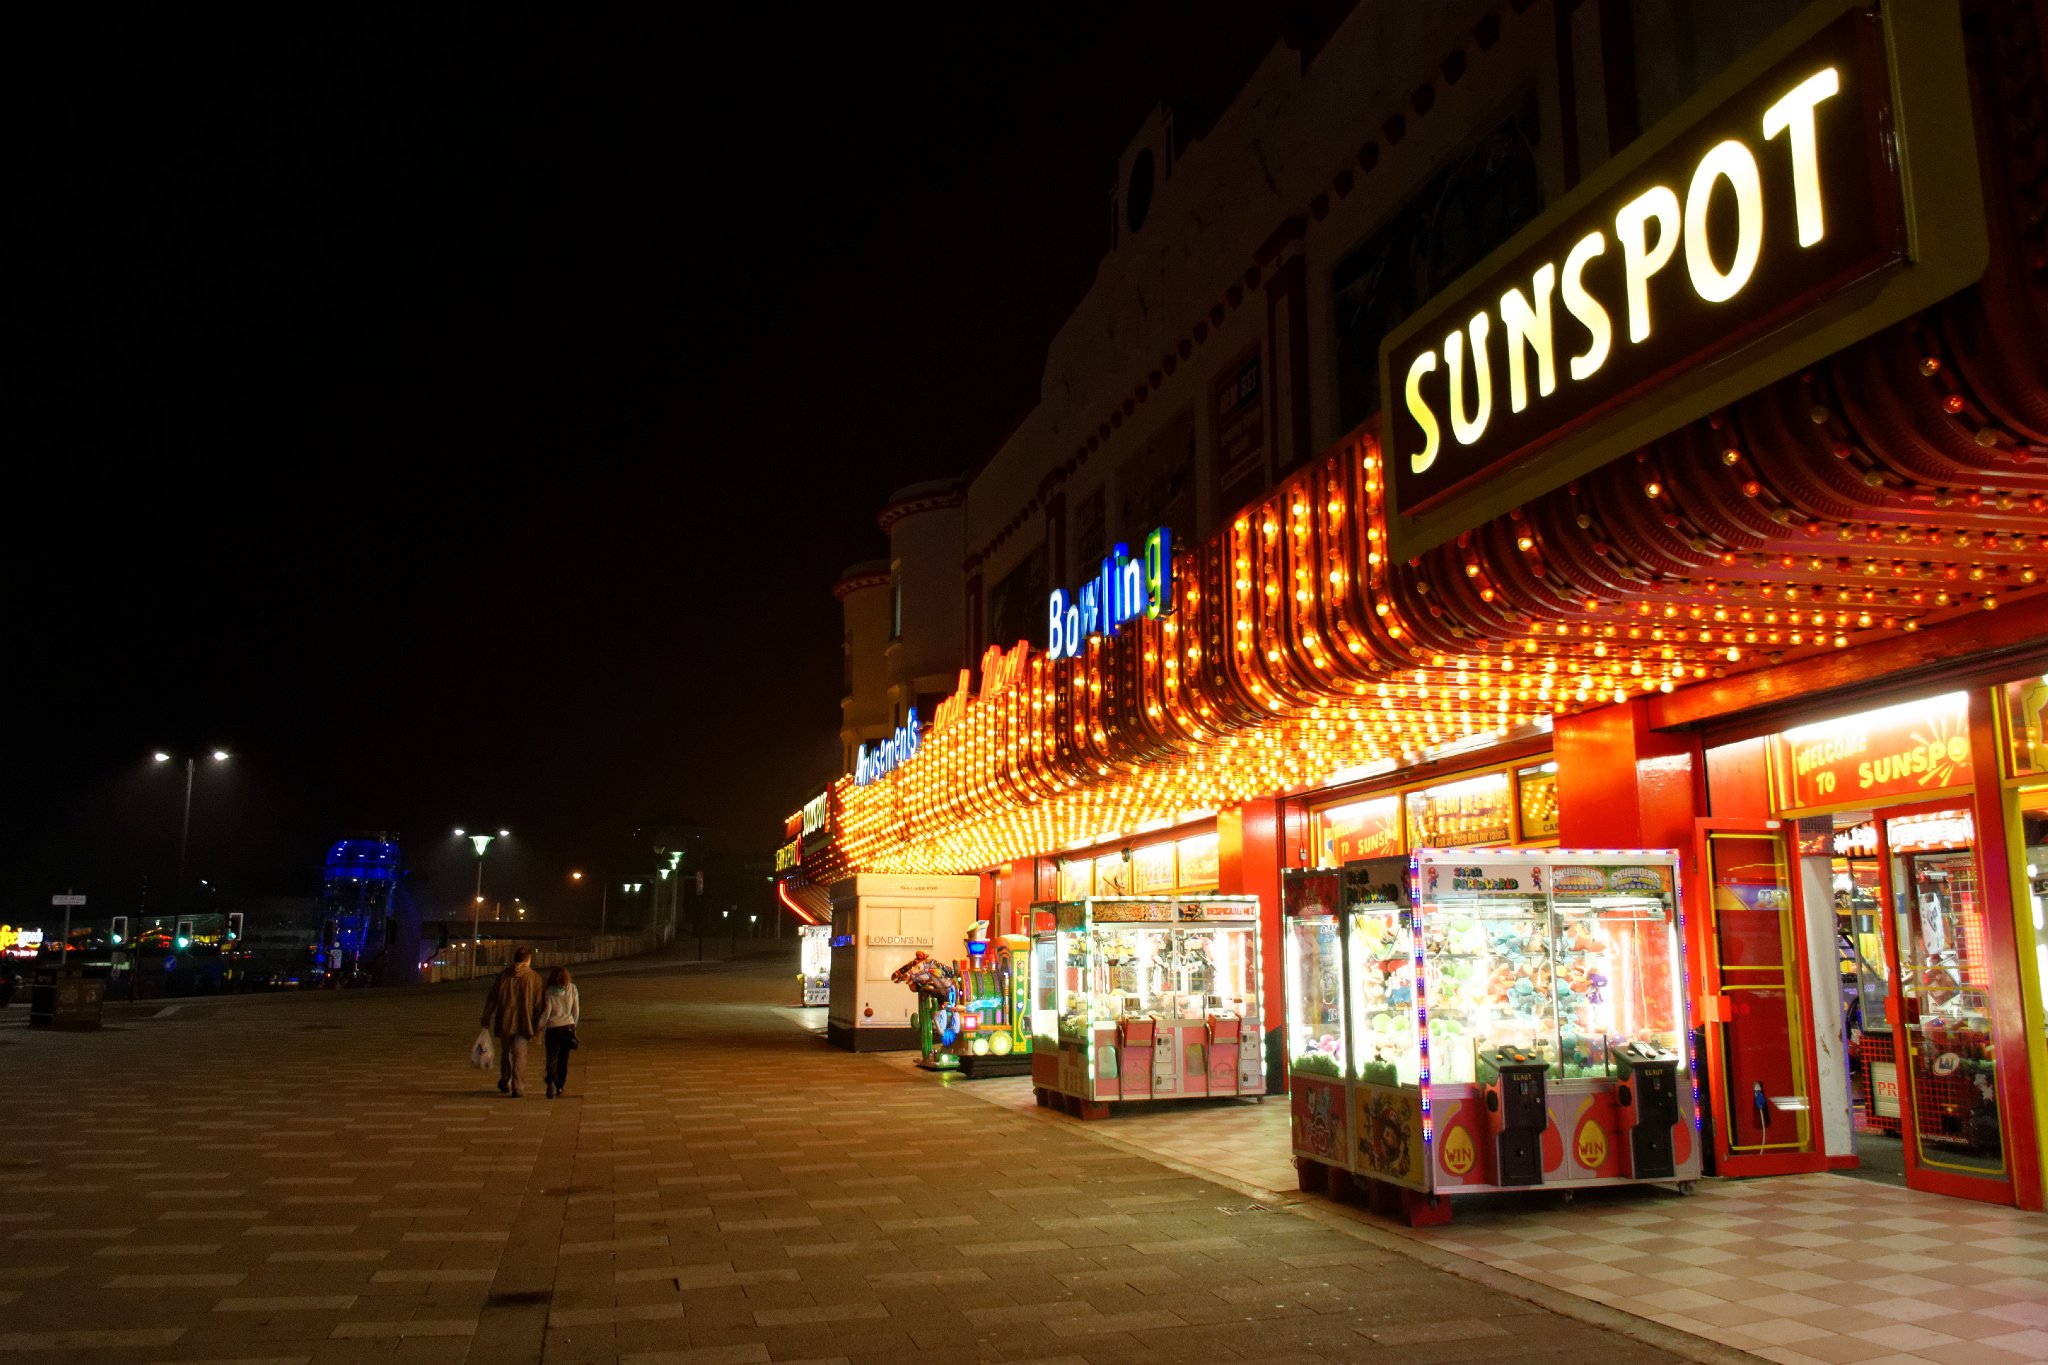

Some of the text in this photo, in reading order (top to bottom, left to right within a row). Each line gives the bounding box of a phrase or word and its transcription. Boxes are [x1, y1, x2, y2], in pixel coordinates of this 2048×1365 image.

[1405, 66, 1840, 475] SUNSPOT
[855, 706, 919, 786] Amusements
[933, 669, 970, 732] and
[1050, 527, 1171, 661] Bowling
[1797, 730, 1868, 776] WELCOME
[1816, 771, 1836, 795] TO
[869, 936, 914, 945] LONDON'S
[1445, 1147, 1472, 1163] WIN
[1579, 1141, 1604, 1155] WIN
